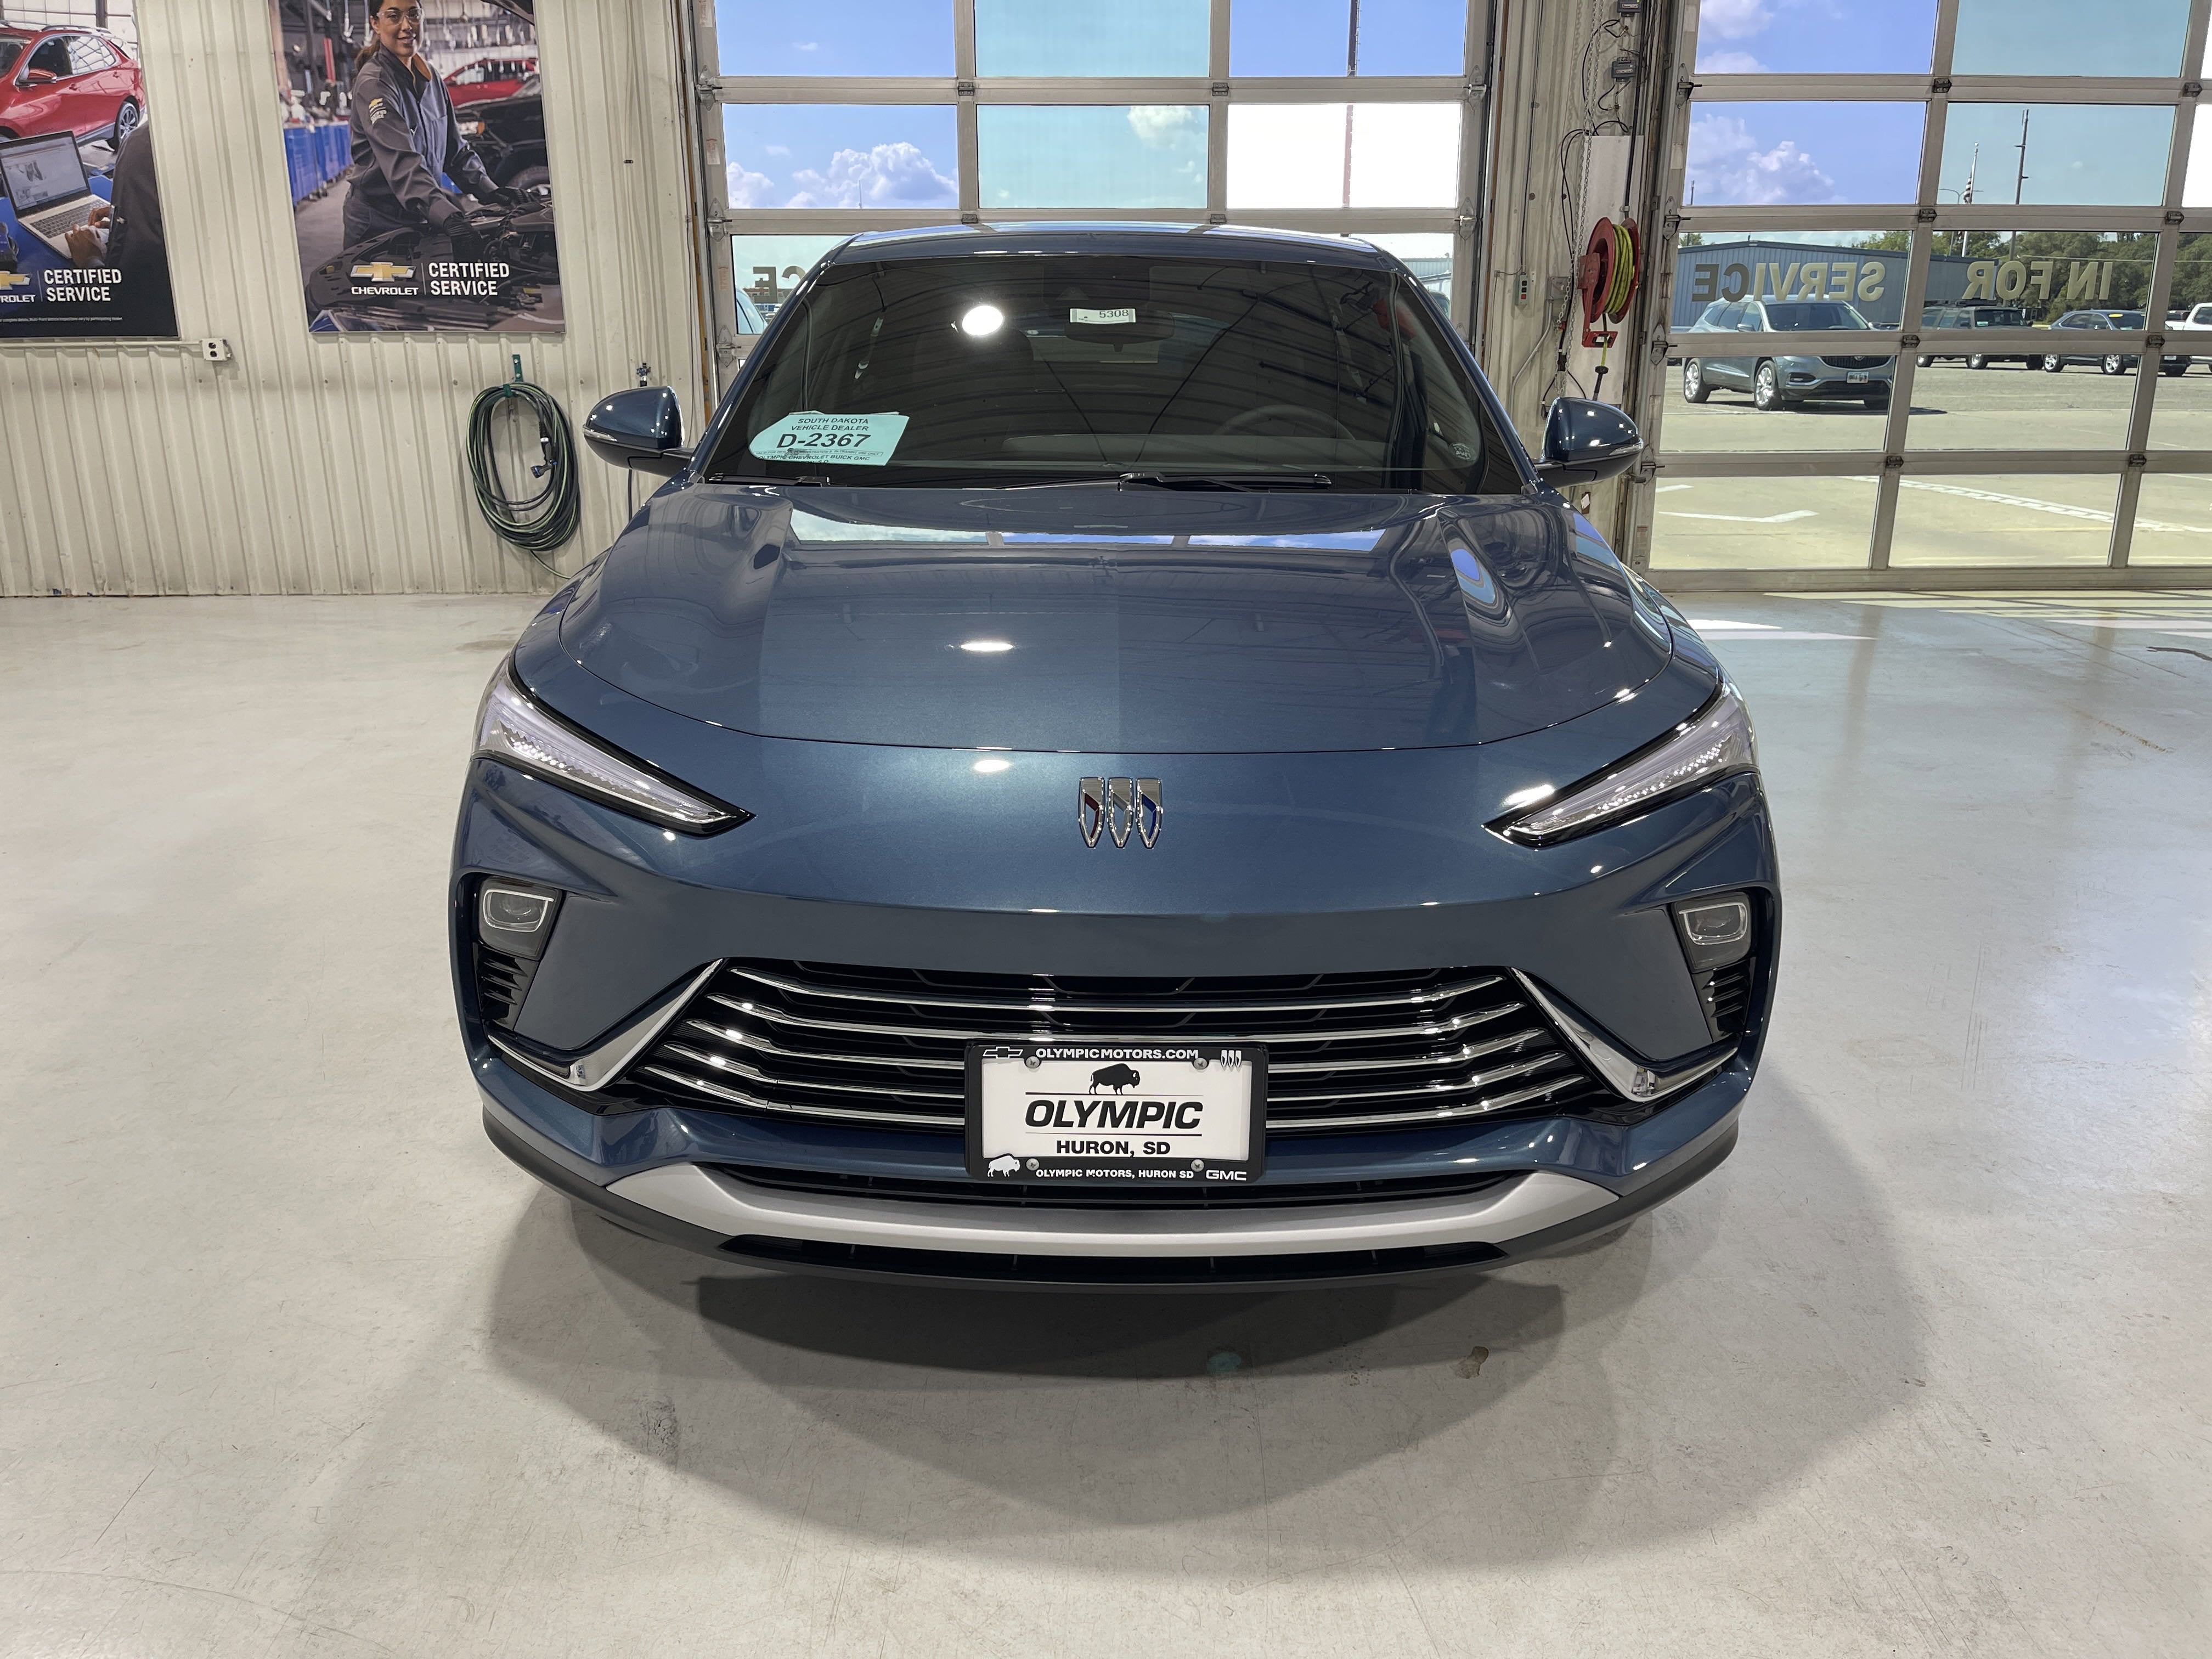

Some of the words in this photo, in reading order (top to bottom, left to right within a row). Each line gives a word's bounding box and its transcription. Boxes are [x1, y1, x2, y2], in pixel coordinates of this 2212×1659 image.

[44, 269, 122, 284] CERTIFIED
[428, 262, 510, 278] CERTIFIED
[46, 286, 111, 301] SERVICE
[351, 286, 419, 295] CHEVROLET
[430, 280, 498, 295] SERVICE
[1099, 309, 1129, 318] 5308
[776, 433, 871, 448] D-2367
[1025, 1099, 1203, 1129] OLYMPIC
[1057, 1141, 1135, 1158] HURON,
[1143, 1141, 1170, 1154] SD
[1036, 1169, 1082, 1177] OLYMPIC
[1086, 1169, 1136, 1179] MOTORS,
[1138, 1170, 1175, 1178] HURON
[1206, 1170, 1247, 1181] GMC
